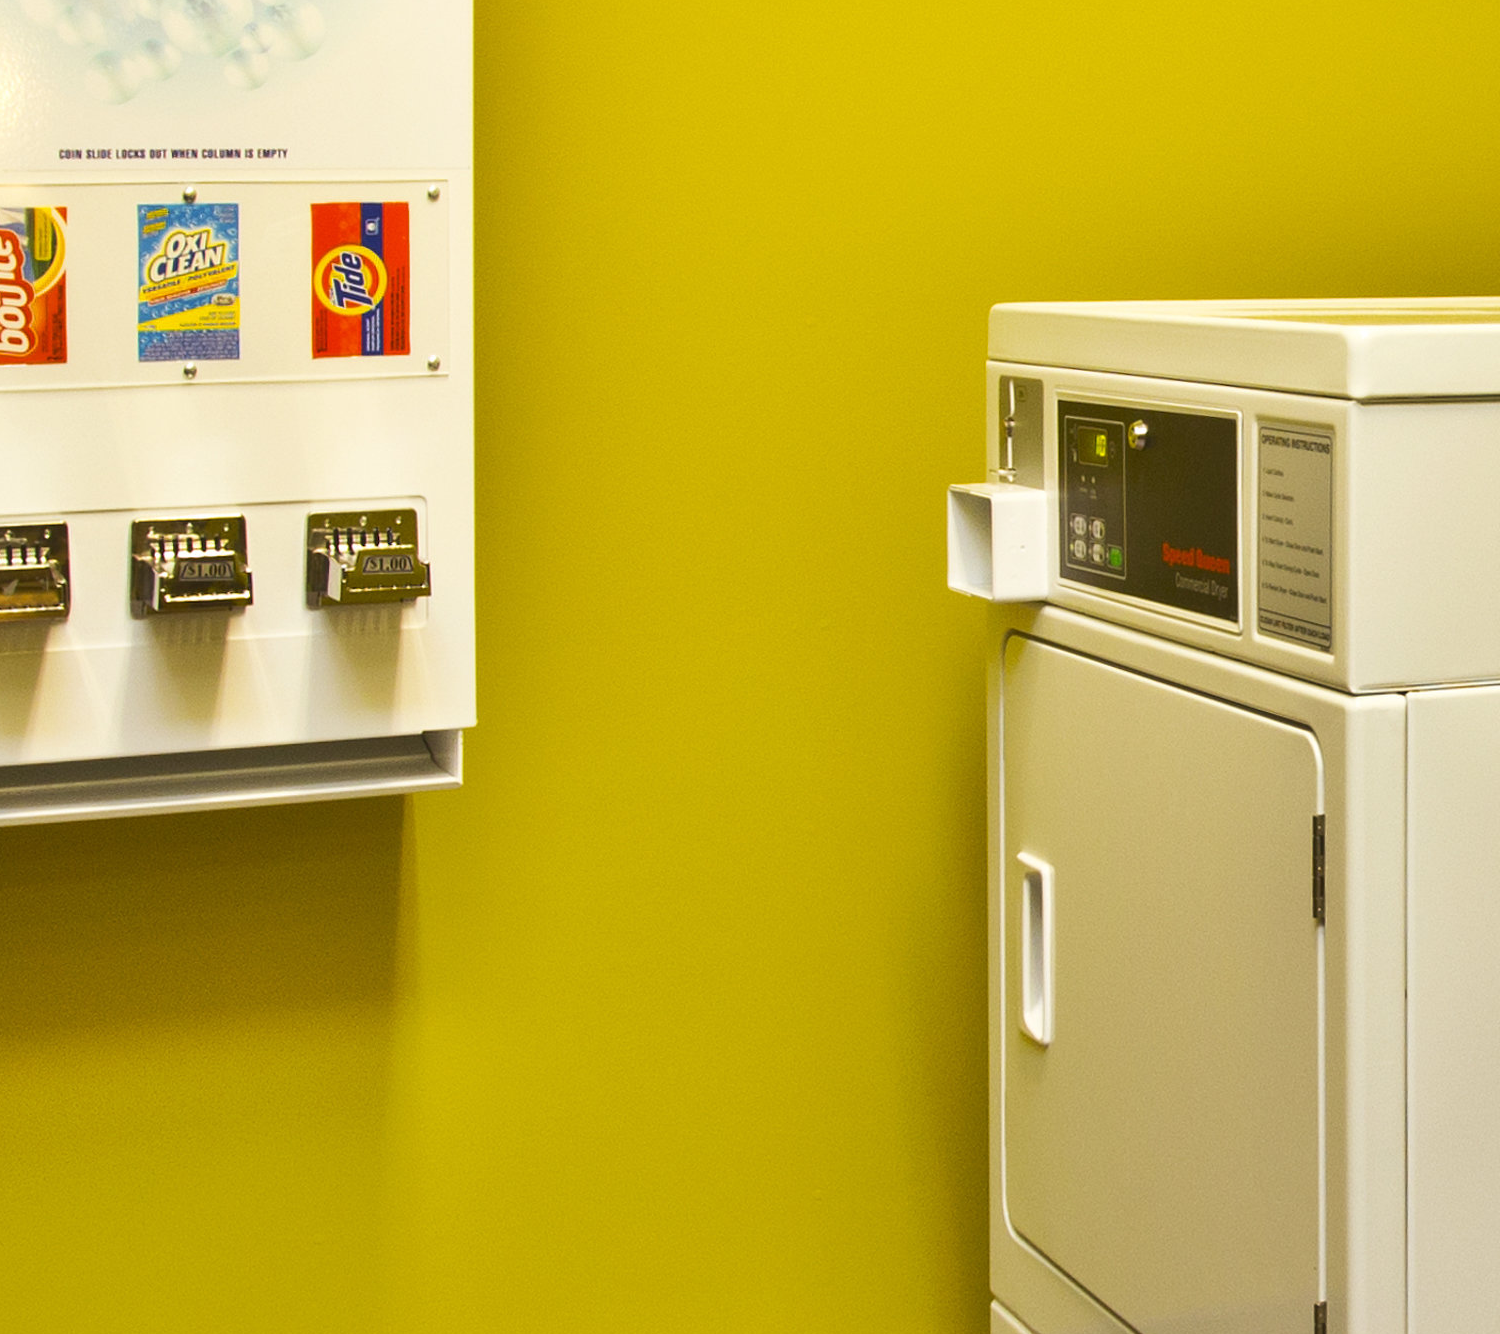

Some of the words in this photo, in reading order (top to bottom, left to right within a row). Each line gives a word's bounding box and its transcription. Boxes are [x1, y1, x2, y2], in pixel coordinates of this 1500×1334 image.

[58, 148, 82, 160] COIN
[85, 148, 112, 160] SLIDE
[116, 148, 146, 160] LOCKS
[149, 148, 167, 160] OUT
[170, 148, 198, 160] WHEN
[201, 148, 242, 160] COLUMN
[245, 148, 254, 160] IS
[257, 148, 288, 160] EMPTY
[166, 231, 209, 259] OXI
[150, 244, 224, 282] CLEAN
[332, 251, 374, 309] Tide
[368, 556, 408, 573] $1.00
[1162, 542, 1195, 567] Speed
[187, 561, 228, 578] $1.00
